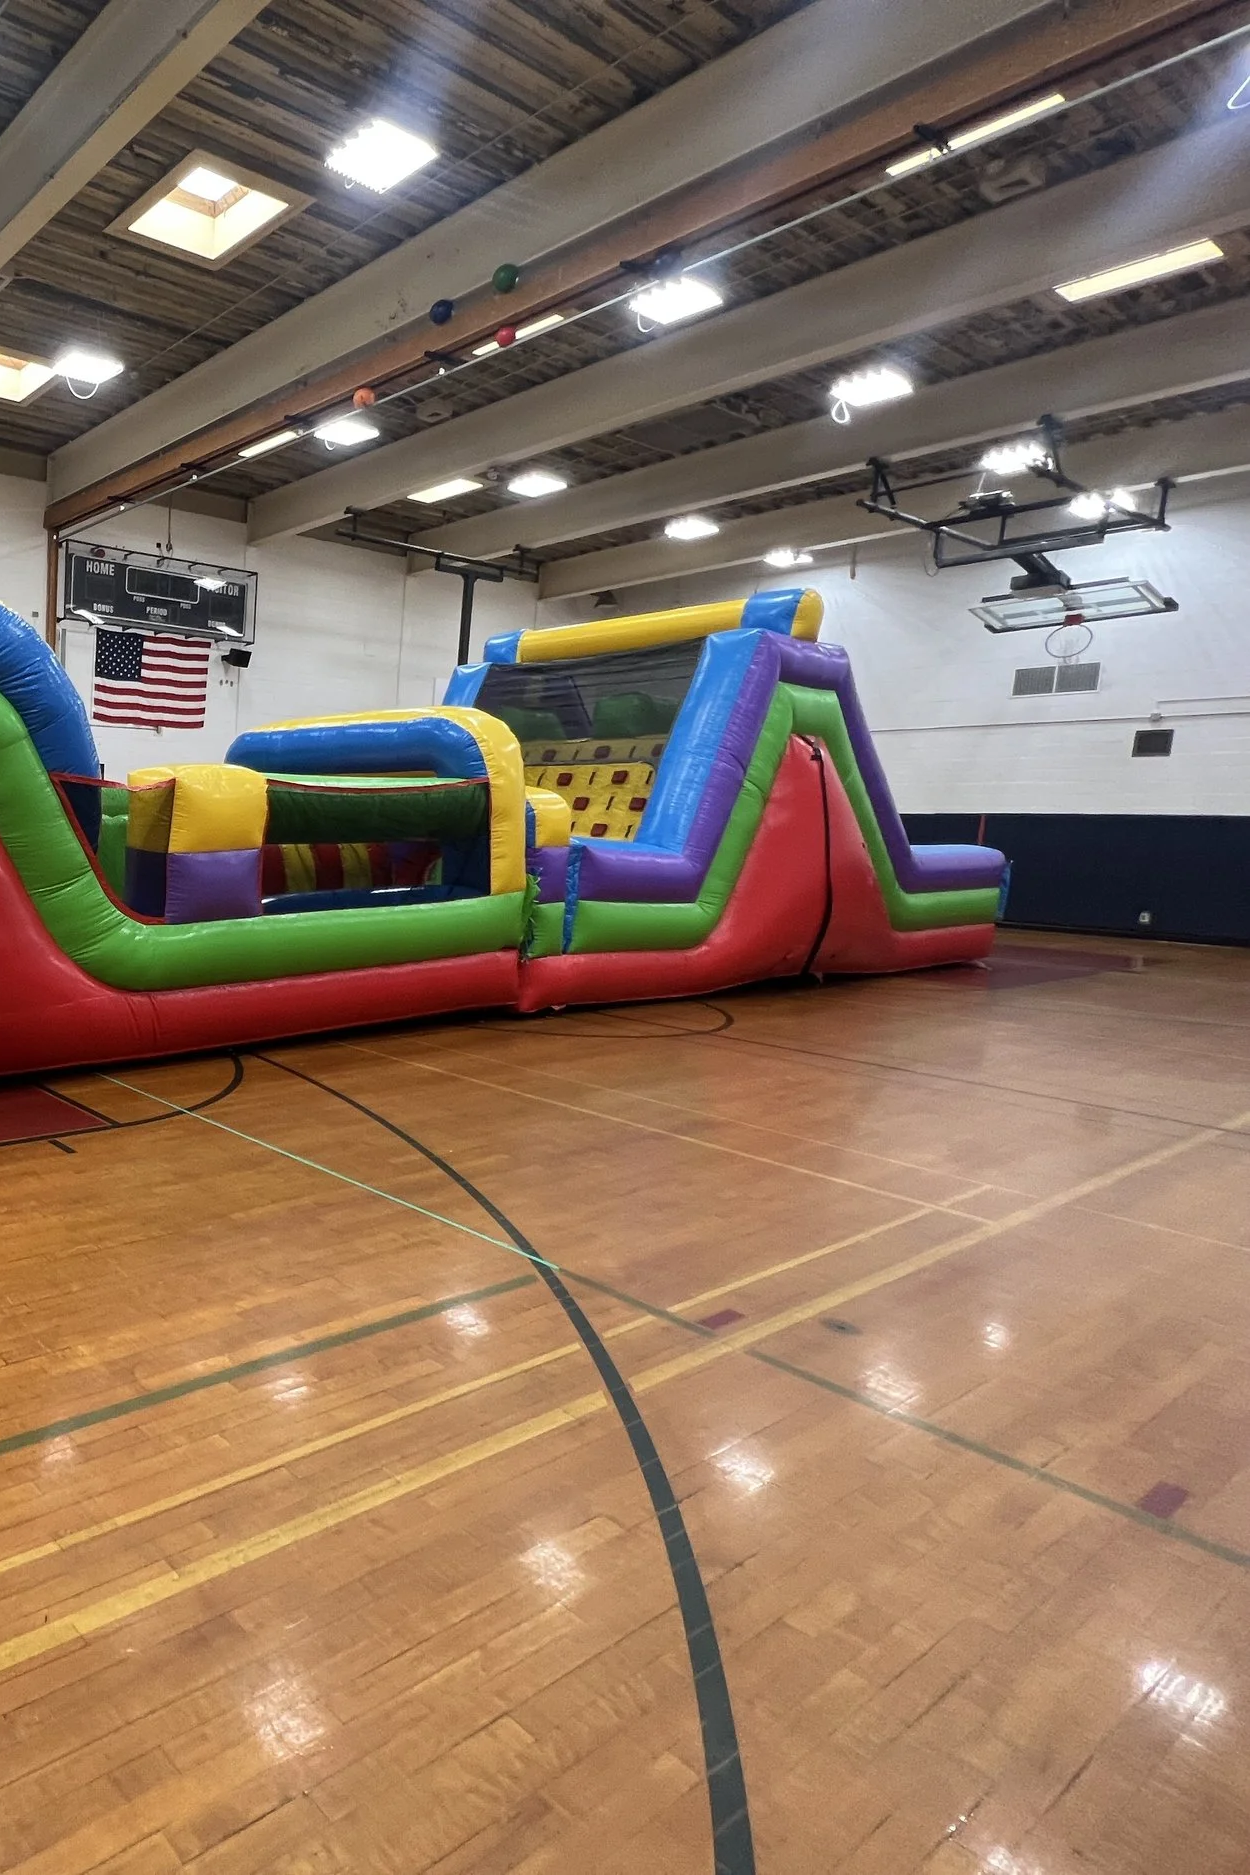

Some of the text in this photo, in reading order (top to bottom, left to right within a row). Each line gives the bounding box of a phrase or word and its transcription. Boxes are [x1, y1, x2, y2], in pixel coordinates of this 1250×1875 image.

[86, 561, 115, 576] HOME
[93, 603, 114, 614] BONUS
[146, 606, 168, 616] PERIOD
